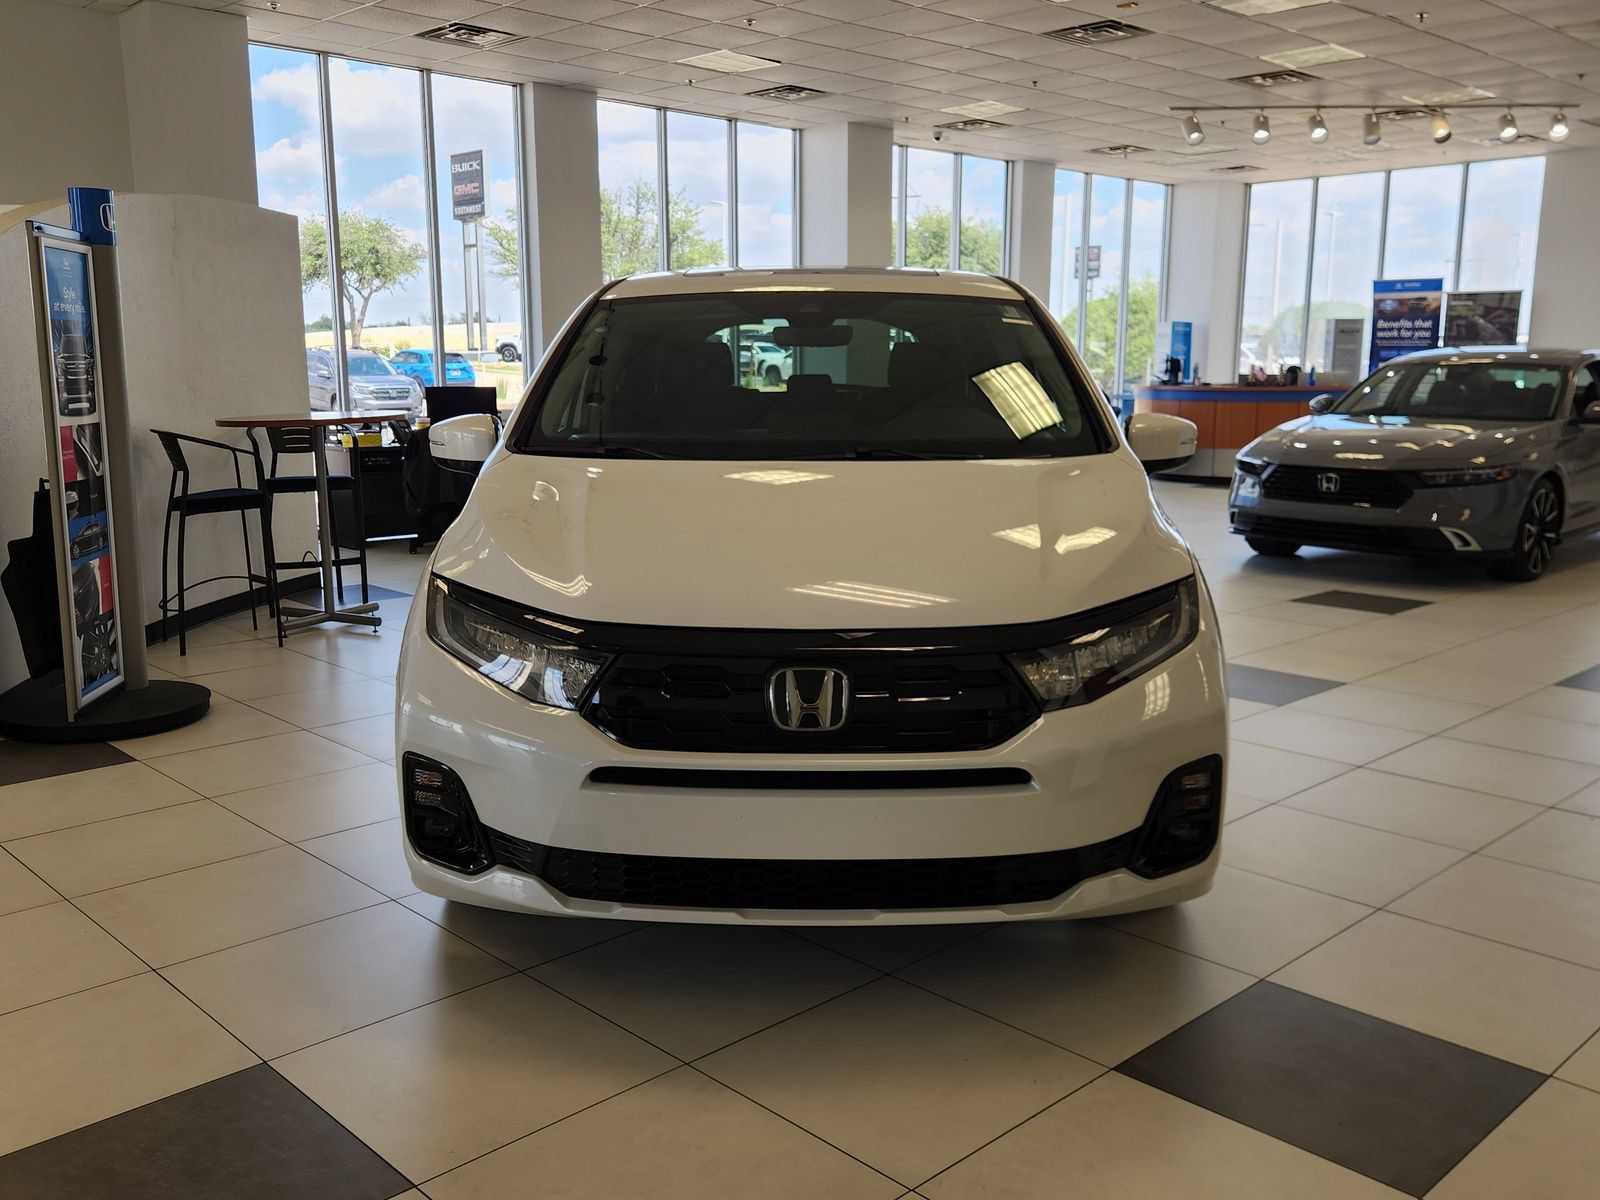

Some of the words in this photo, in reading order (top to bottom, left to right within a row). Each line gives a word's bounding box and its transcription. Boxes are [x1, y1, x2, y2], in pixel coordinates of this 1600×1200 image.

[451, 160, 481, 173] BUICK
[454, 183, 479, 196] GMC
[53, 301, 60, 311] at
[1376, 318, 1413, 329] Benefits
[1414, 318, 1433, 329] that
[1376, 329, 1399, 338] work
[1400, 329, 1413, 338] for
[1413, 330, 1432, 340] you
